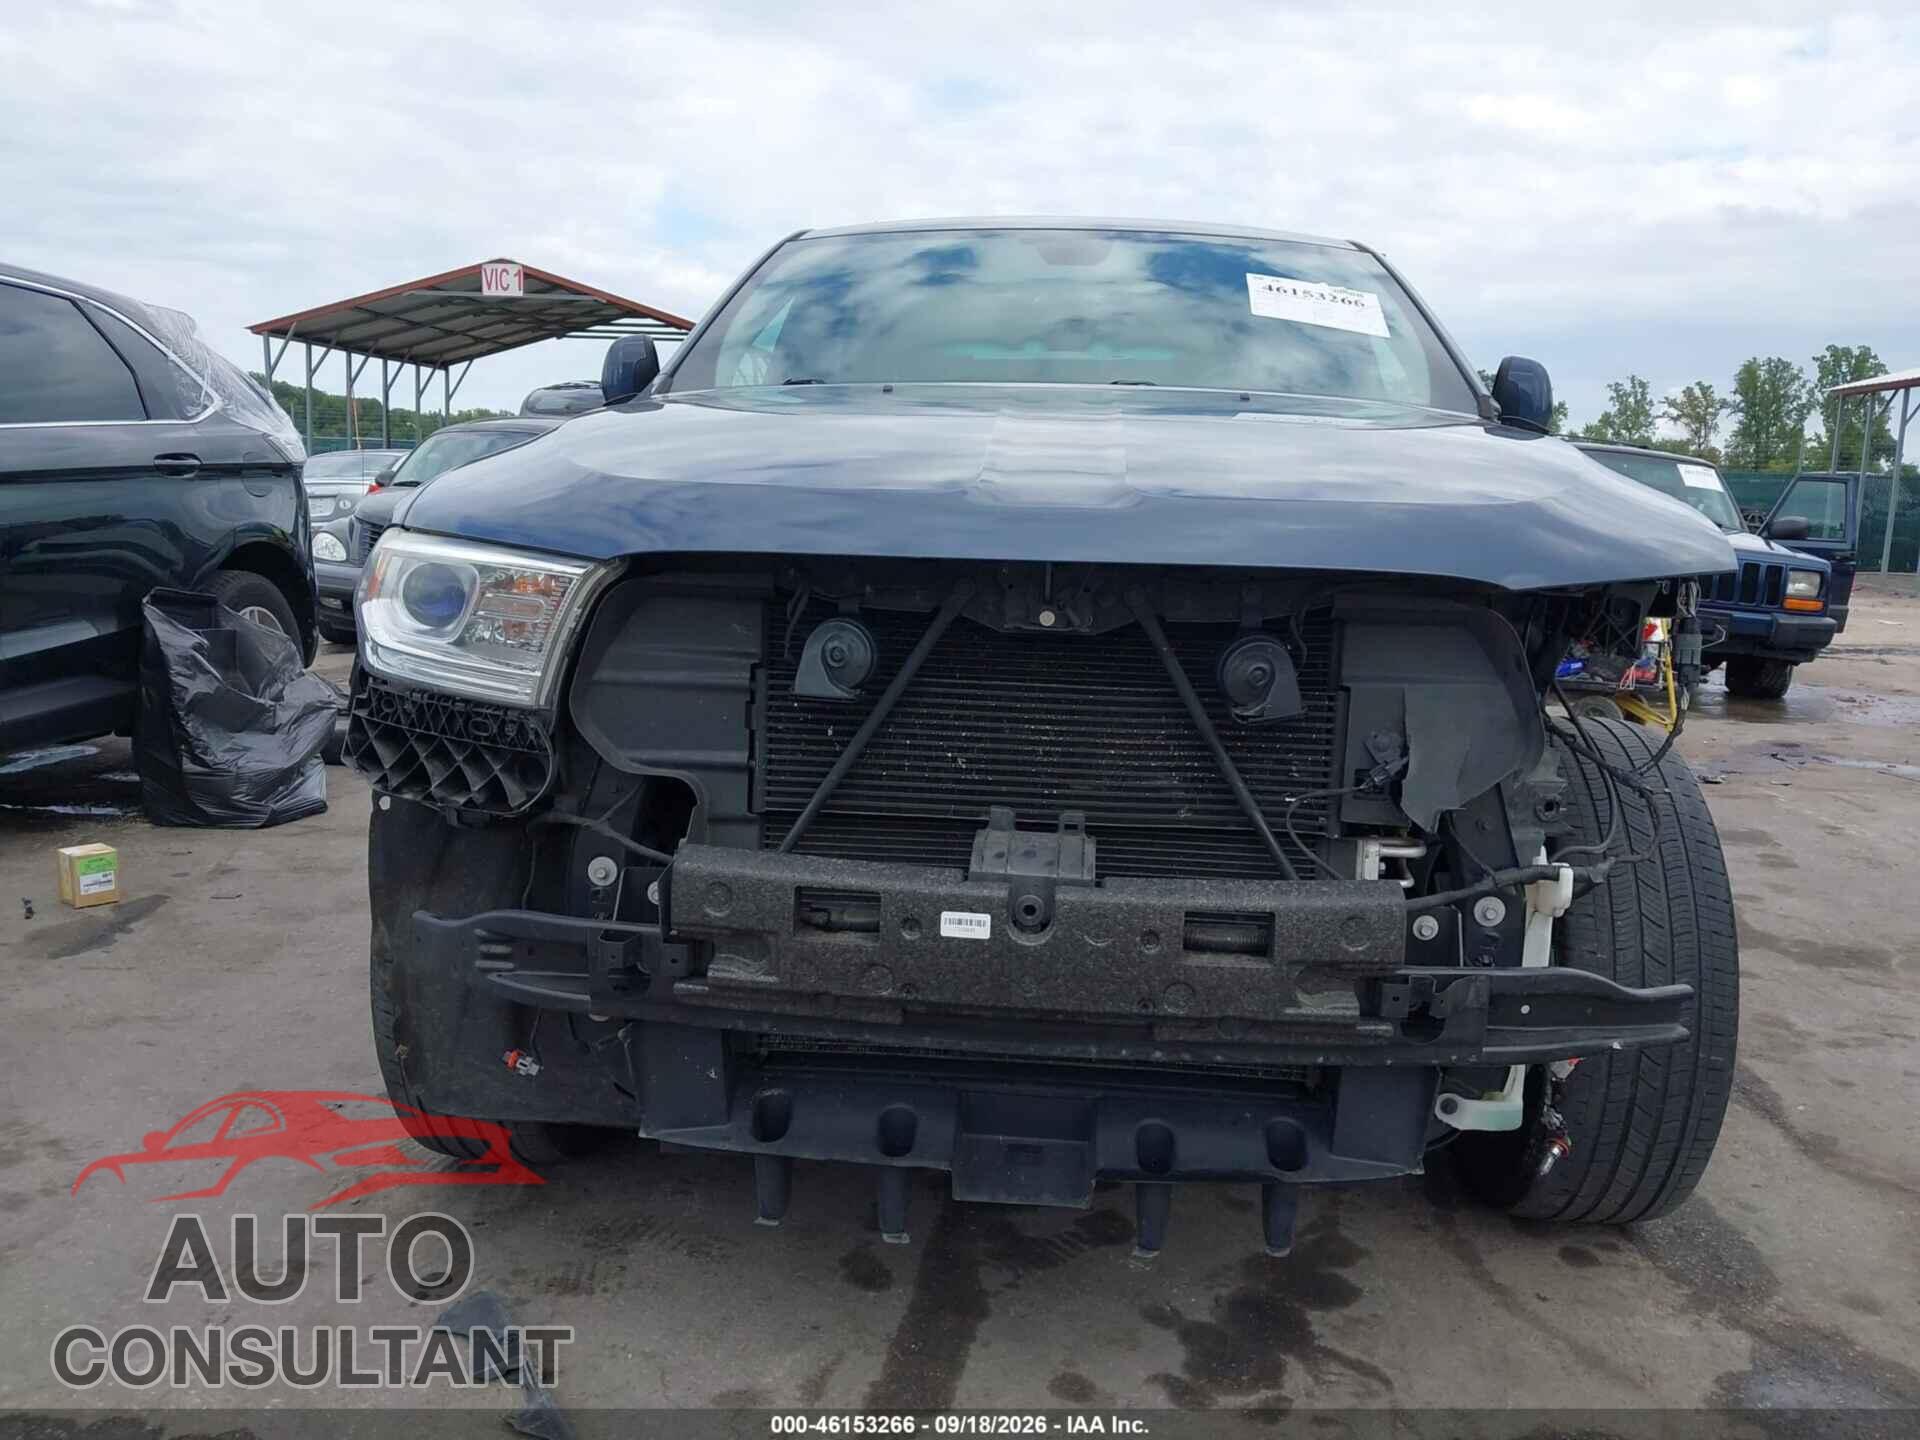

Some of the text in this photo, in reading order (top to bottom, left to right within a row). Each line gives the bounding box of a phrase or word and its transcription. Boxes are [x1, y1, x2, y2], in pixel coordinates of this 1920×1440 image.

[483, 268, 522, 291] VIC 1
[1262, 283, 1366, 307] 46153266
